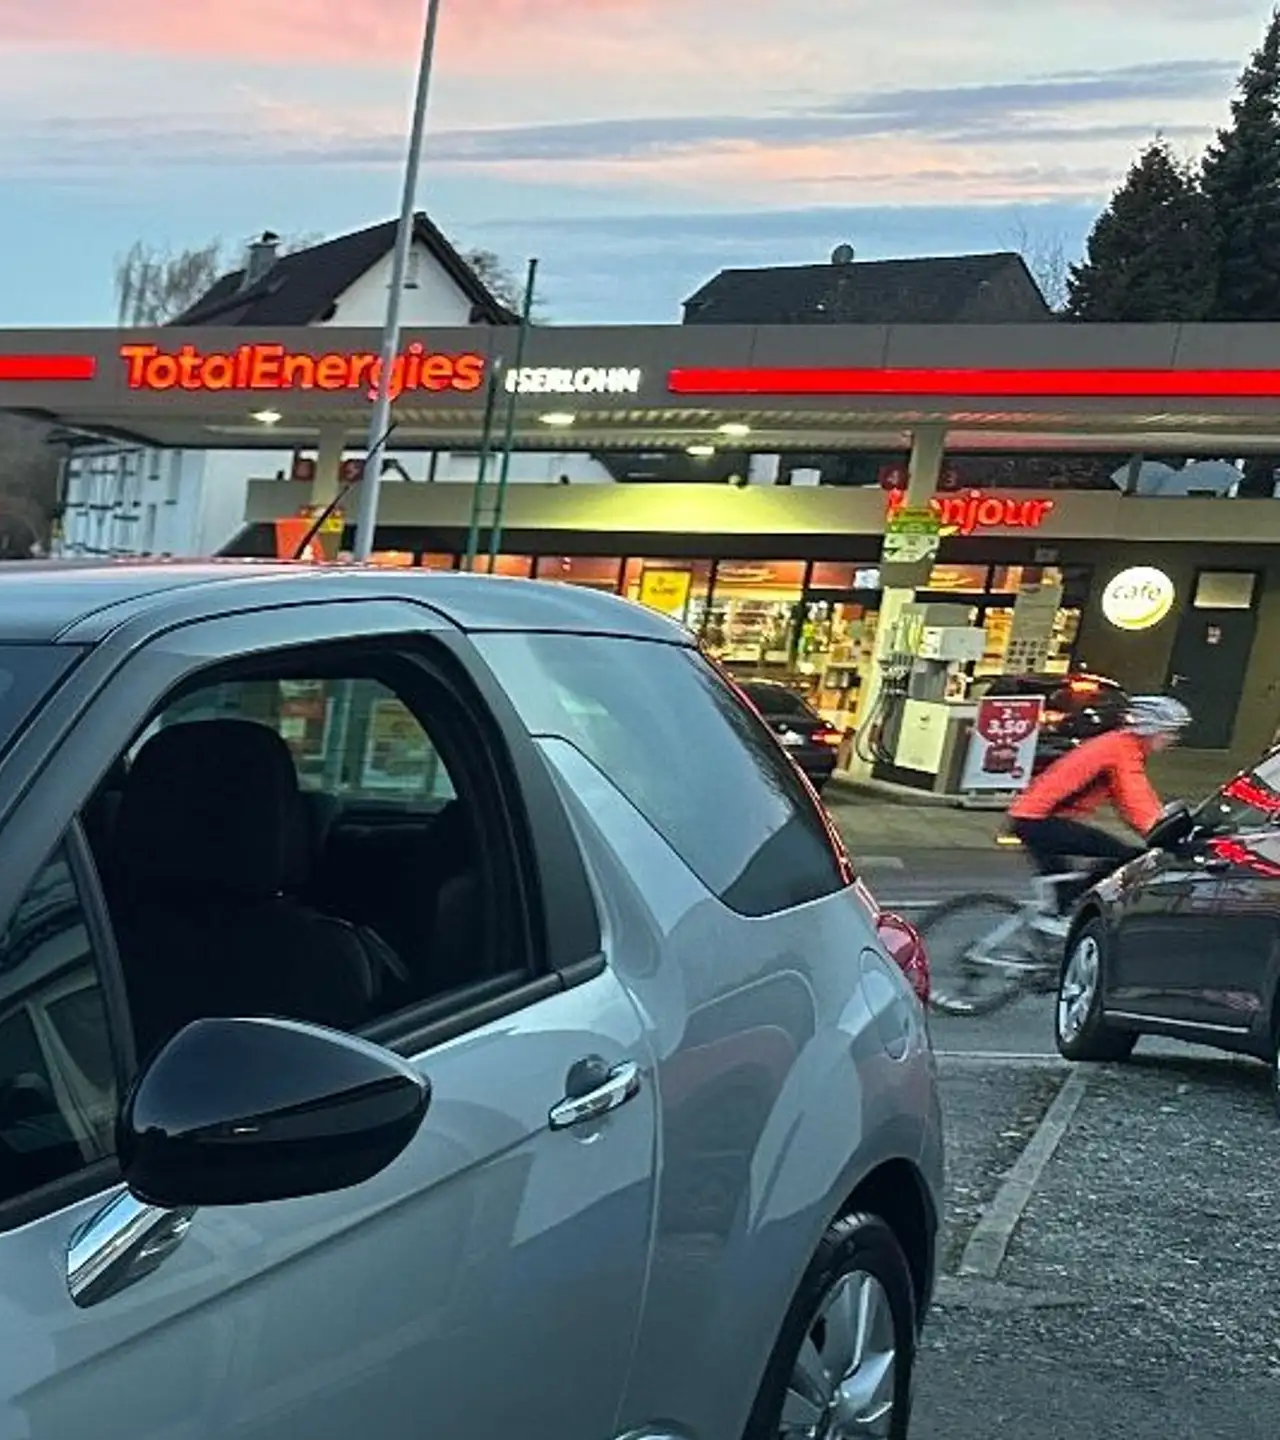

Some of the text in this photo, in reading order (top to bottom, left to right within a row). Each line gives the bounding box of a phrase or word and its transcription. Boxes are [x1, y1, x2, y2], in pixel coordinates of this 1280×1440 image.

[120, 342, 485, 402] TotalEnergies
[504, 367, 641, 393] ISERLOHN
[886, 488, 1055, 536] bnjour
